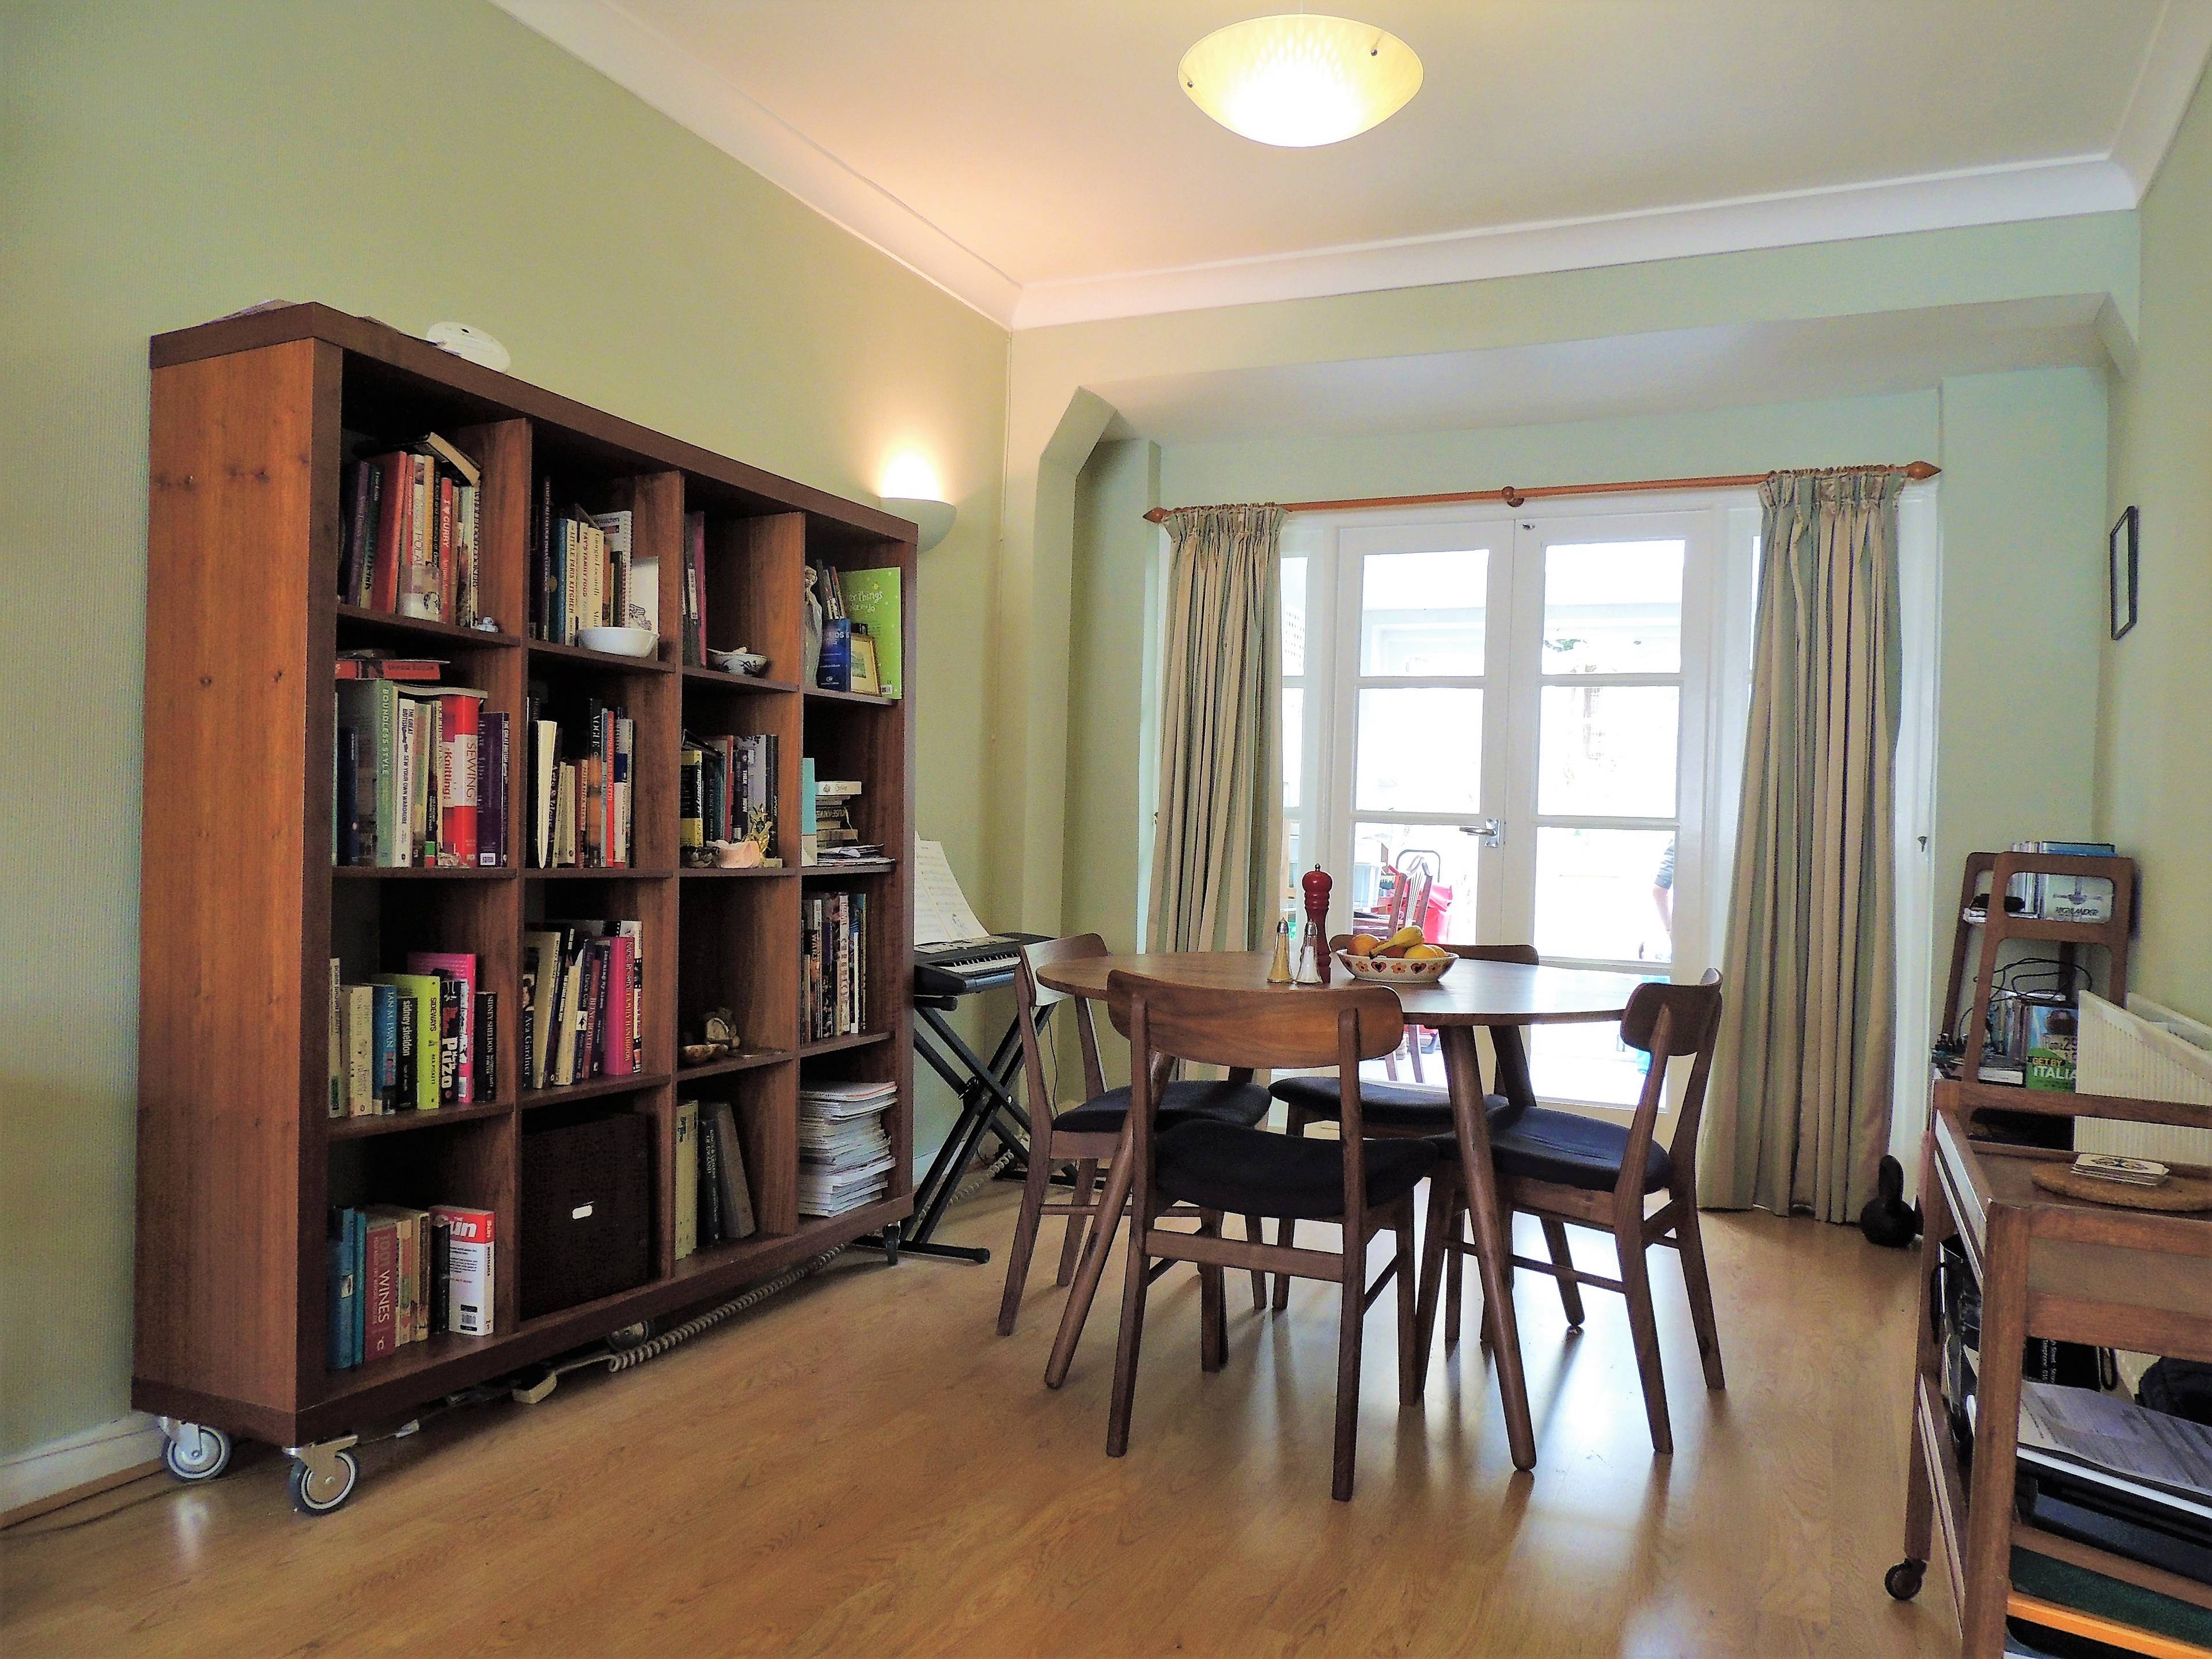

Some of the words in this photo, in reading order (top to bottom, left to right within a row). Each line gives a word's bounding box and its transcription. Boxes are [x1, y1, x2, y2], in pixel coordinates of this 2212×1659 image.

[381, 688, 389, 744] BOUNDLESS
[592, 714, 600, 747] VOGUE
[381, 747, 389, 775] STYLE
[444, 751, 453, 796] Knitting
[466, 742, 476, 798] SEWING
[401, 1000, 412, 1025] sidney
[524, 1016, 532, 1033] Ava
[402, 1026, 412, 1056] sheldon
[524, 1036, 532, 1077] Gardner
[441, 1037, 458, 1089] Puzo
[2032, 1057, 2049, 1066] GET
[2050, 1058, 2062, 1067] BY
[2033, 1065, 2077, 1079] ITALIA
[449, 1219, 478, 1239] un
[377, 1269, 391, 1324] WINES
